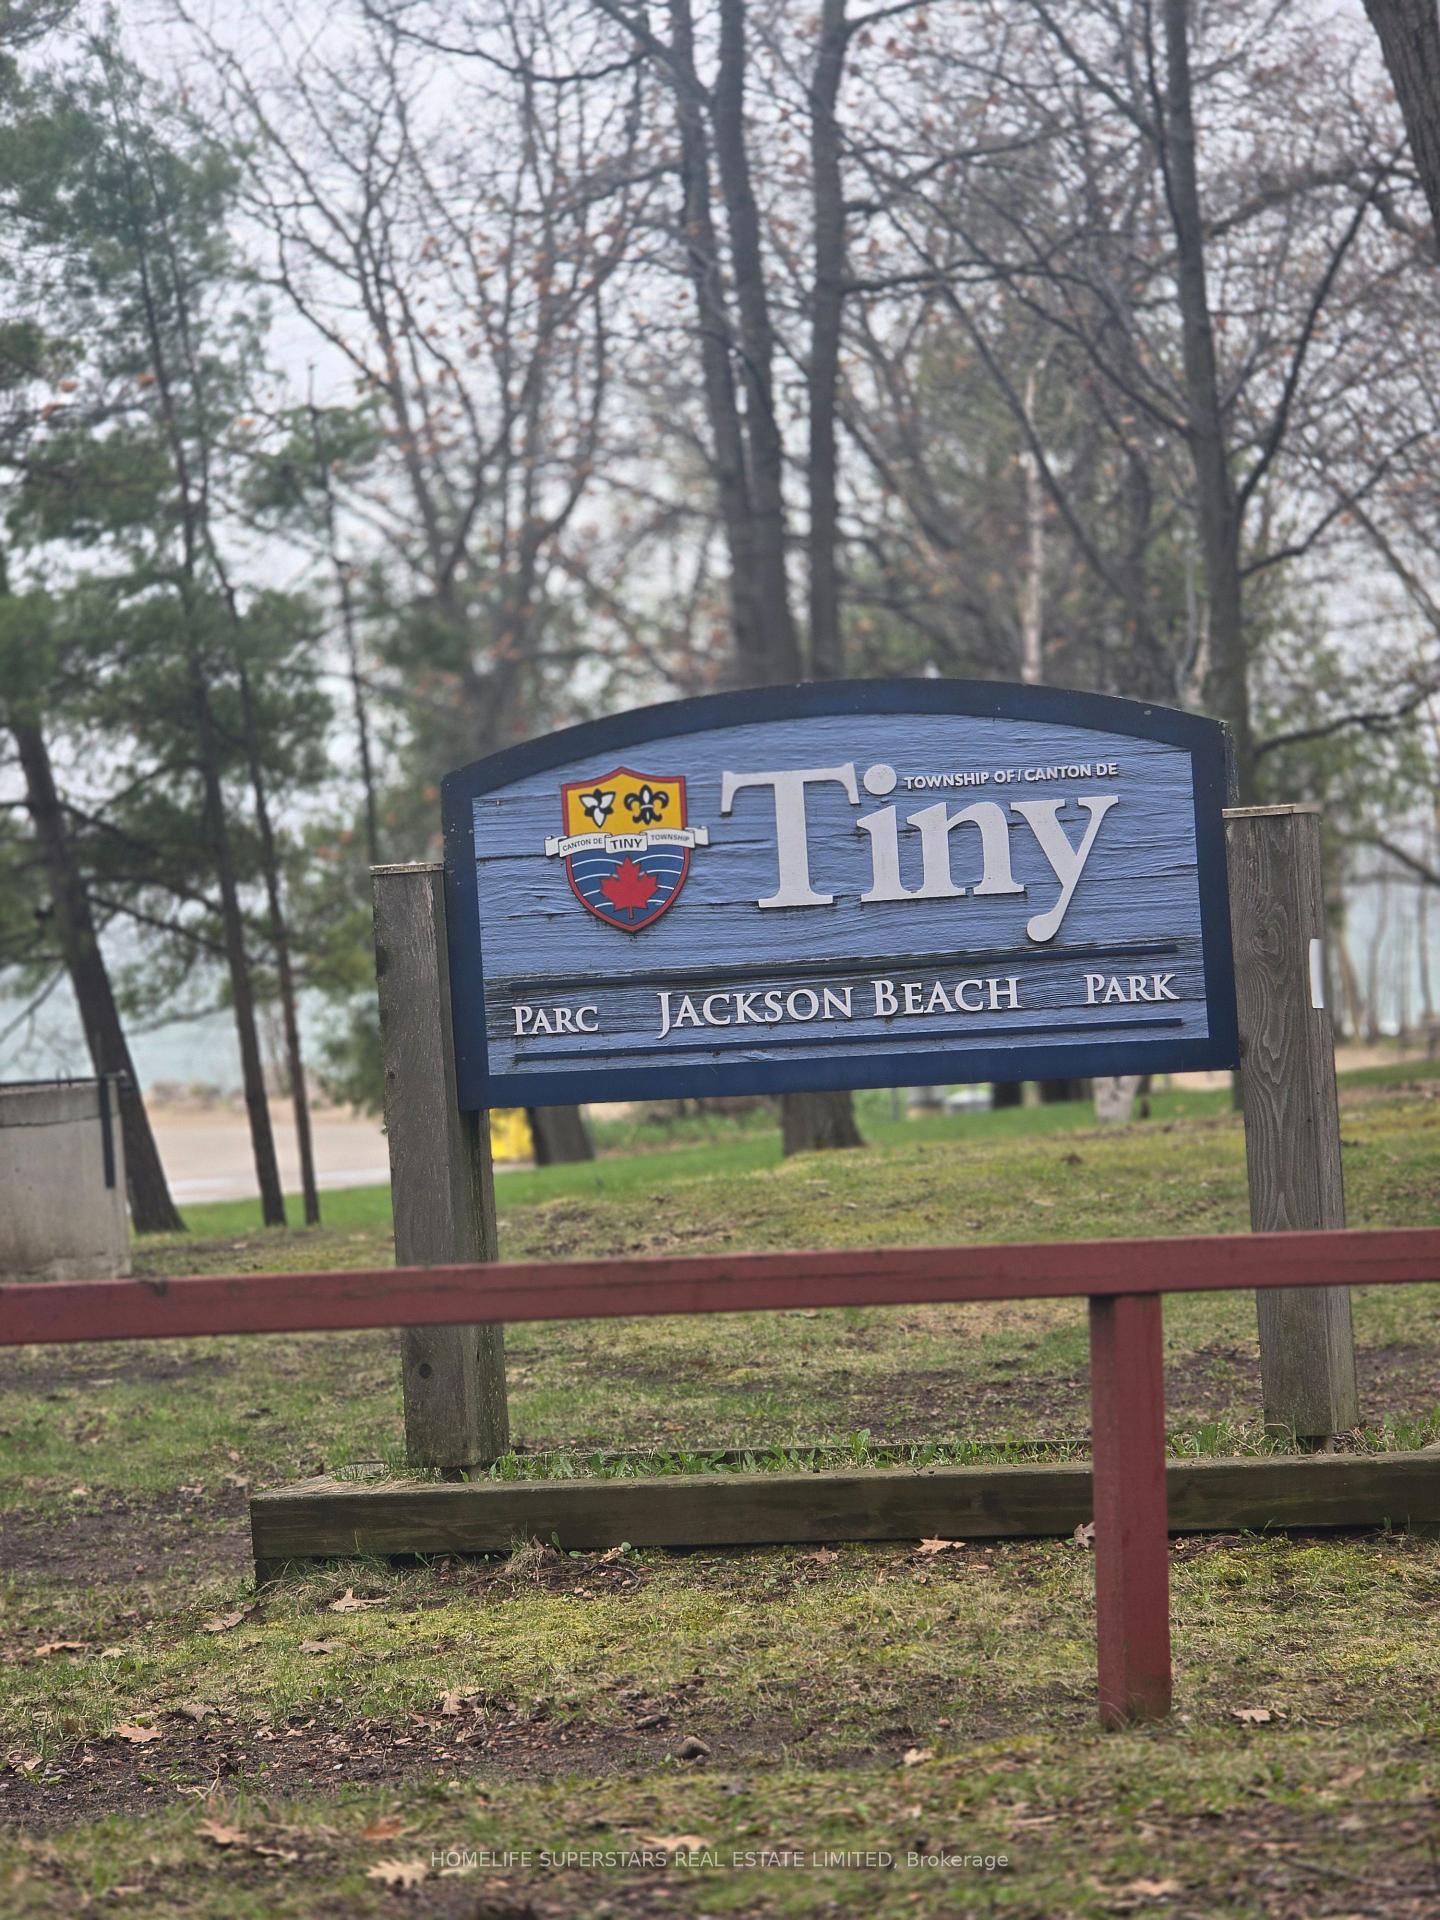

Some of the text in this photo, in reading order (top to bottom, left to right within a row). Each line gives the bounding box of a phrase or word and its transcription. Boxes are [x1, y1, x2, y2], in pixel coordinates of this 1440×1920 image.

[904, 771, 989, 790] TOWNSHIP
[1095, 762, 1119, 776] DE
[562, 833, 690, 852] CANTON DE TINY TOWNSHIP
[721, 762, 1119, 942] Tiny
[511, 974, 1180, 1040] PARC JACKSON BEACH PARK
